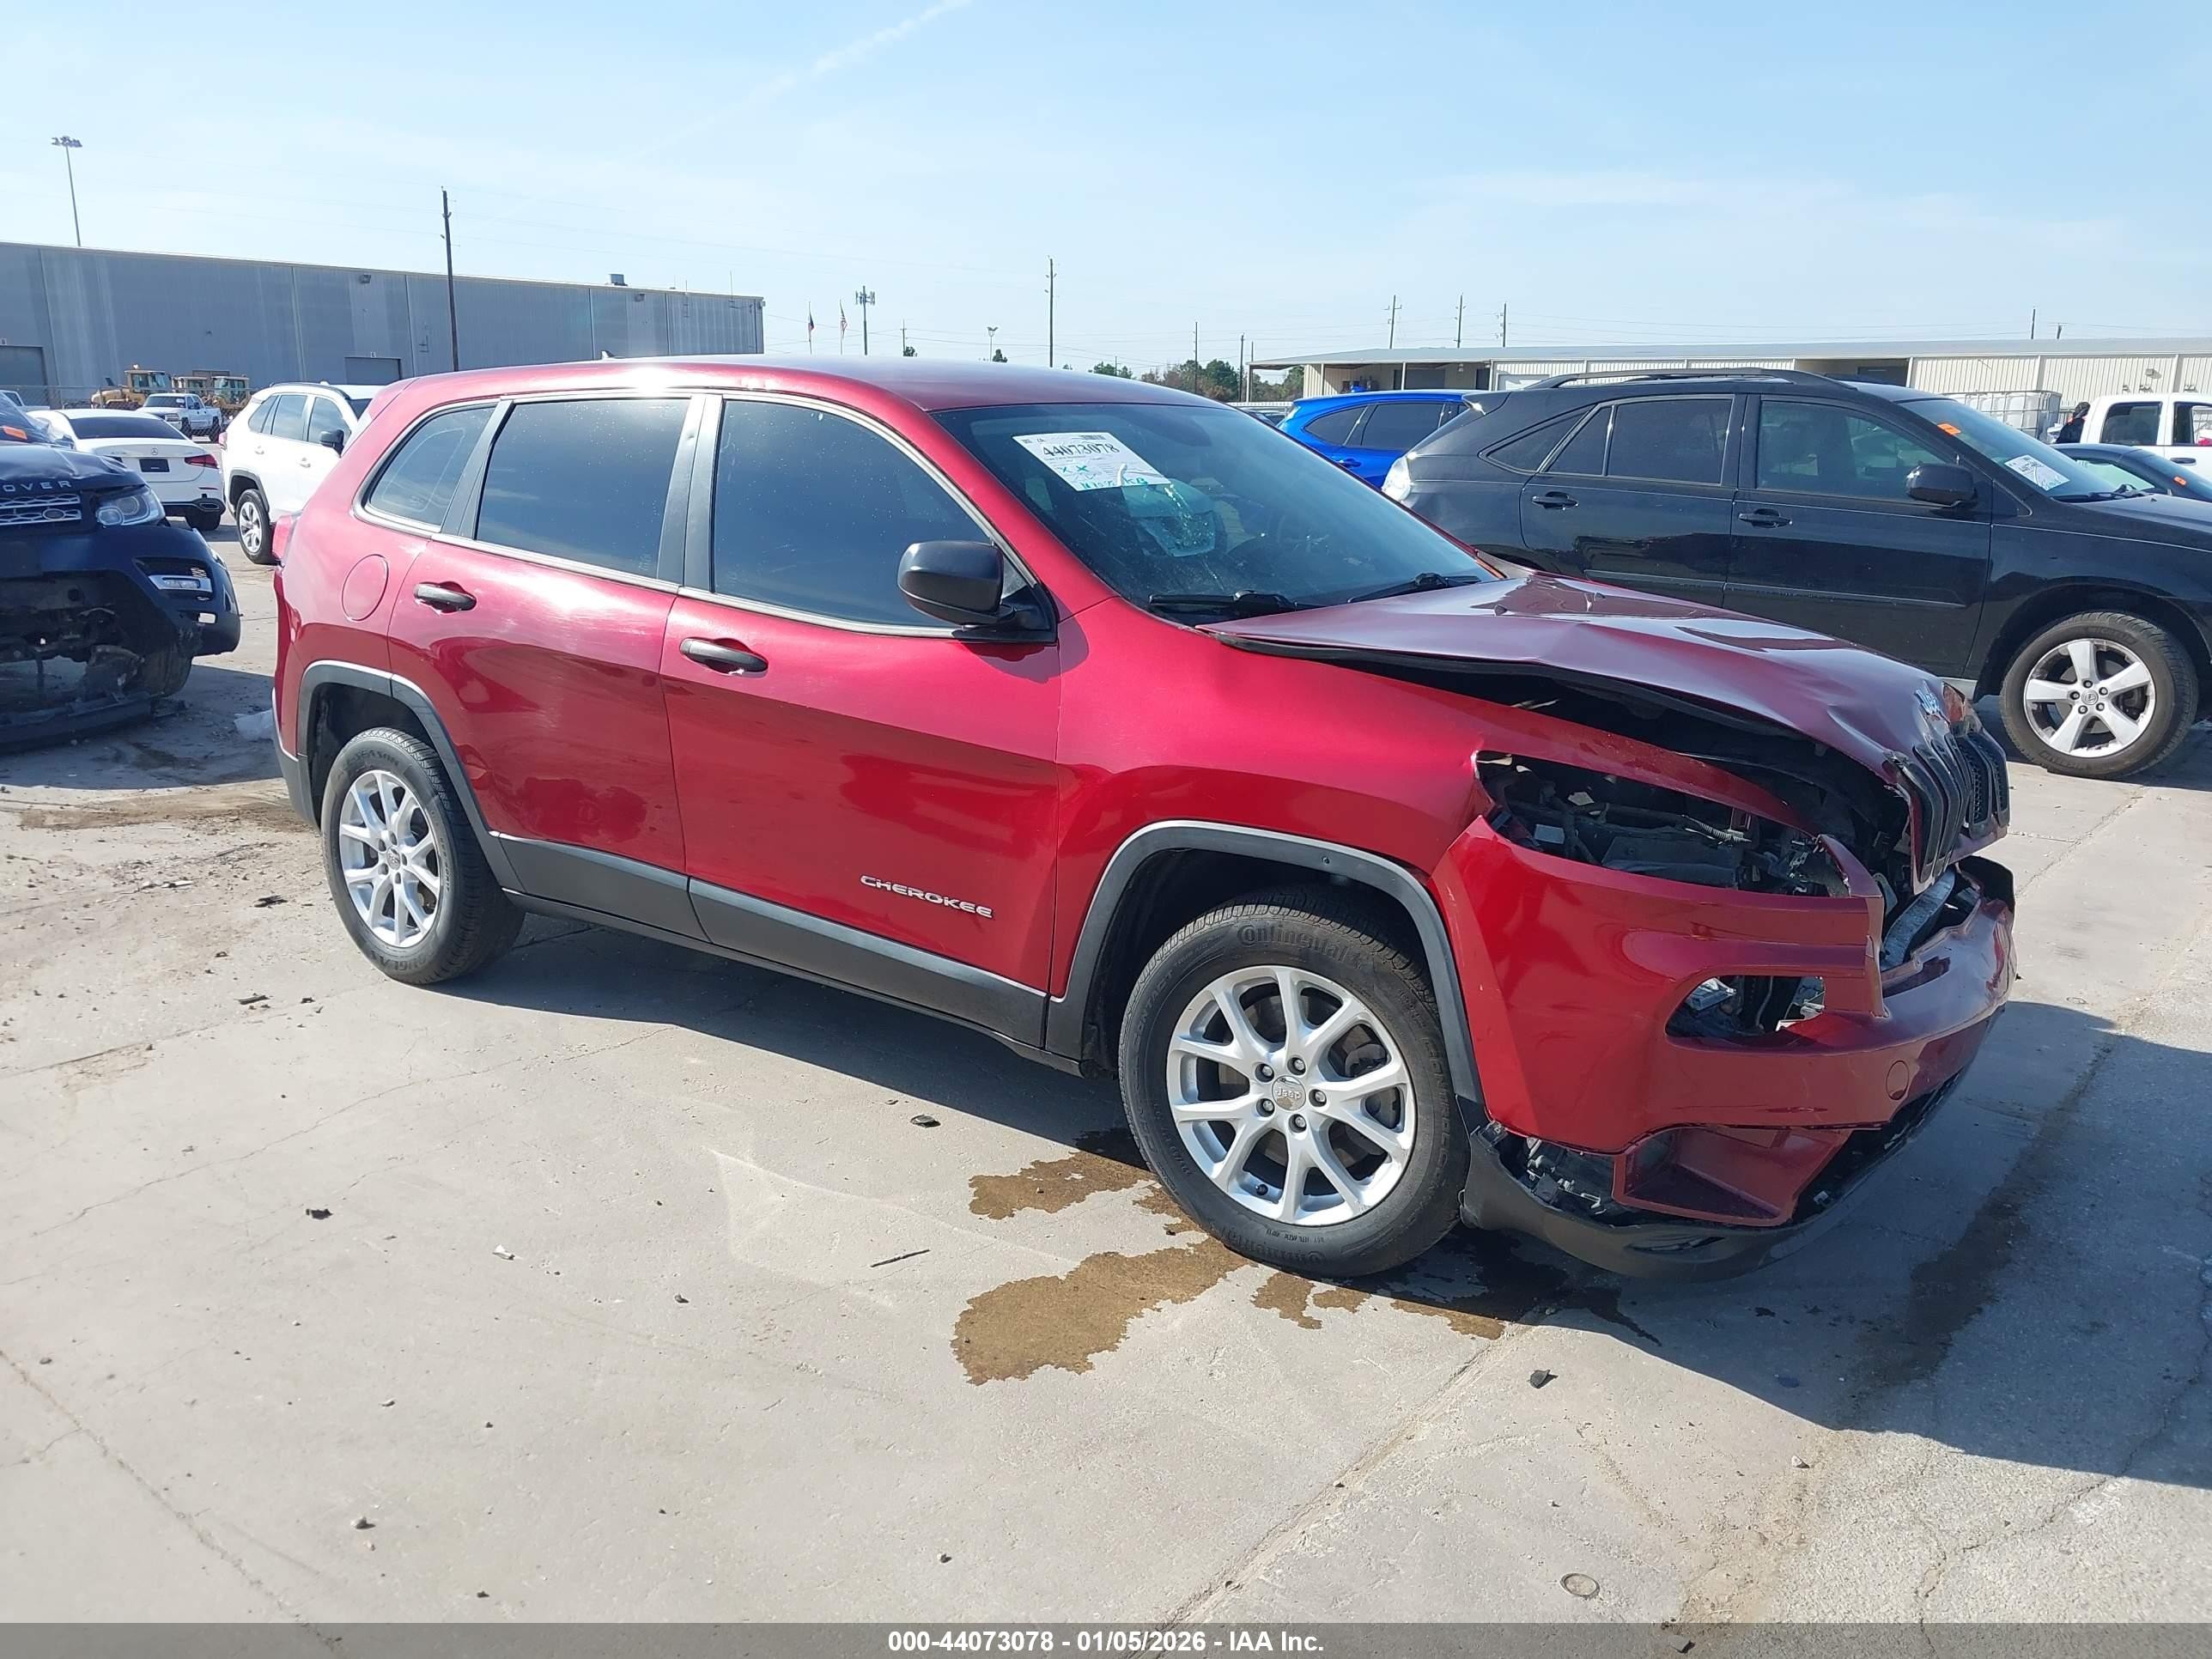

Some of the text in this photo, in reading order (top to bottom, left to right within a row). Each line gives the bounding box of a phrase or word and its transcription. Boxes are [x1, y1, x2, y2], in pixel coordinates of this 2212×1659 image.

[1043, 443, 1120, 456] 44073078
[3, 481, 71, 492] OVER
[860, 875, 993, 918] CHEROKEE
[1239, 924, 1347, 962] Continental
